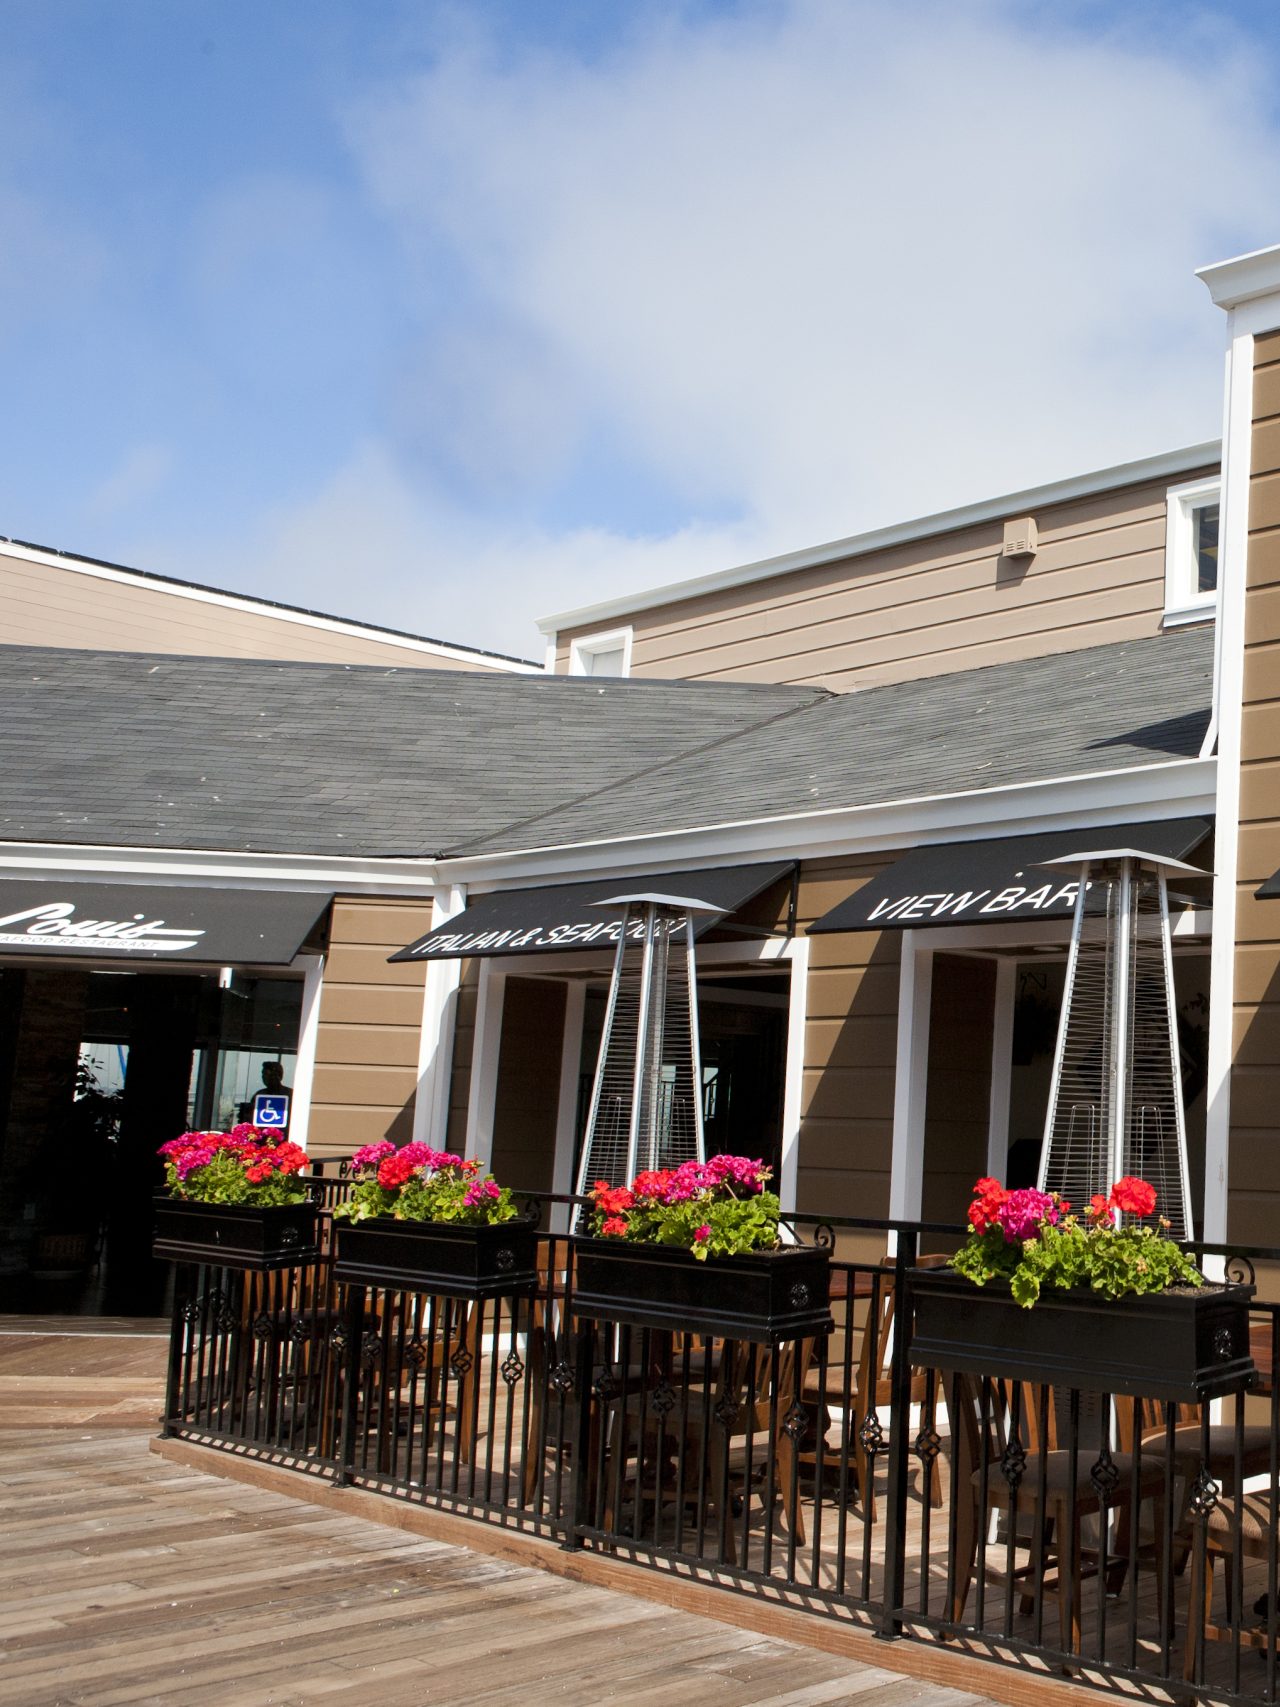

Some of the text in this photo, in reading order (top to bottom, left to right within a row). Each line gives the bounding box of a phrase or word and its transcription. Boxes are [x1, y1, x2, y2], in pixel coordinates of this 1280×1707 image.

[866, 881, 1093, 921] VIEW BAR
[0, 934, 161, 949] AFOOD RESTAURANT
[411, 928, 514, 954] ITALIAN
[510, 926, 544, 948] &
